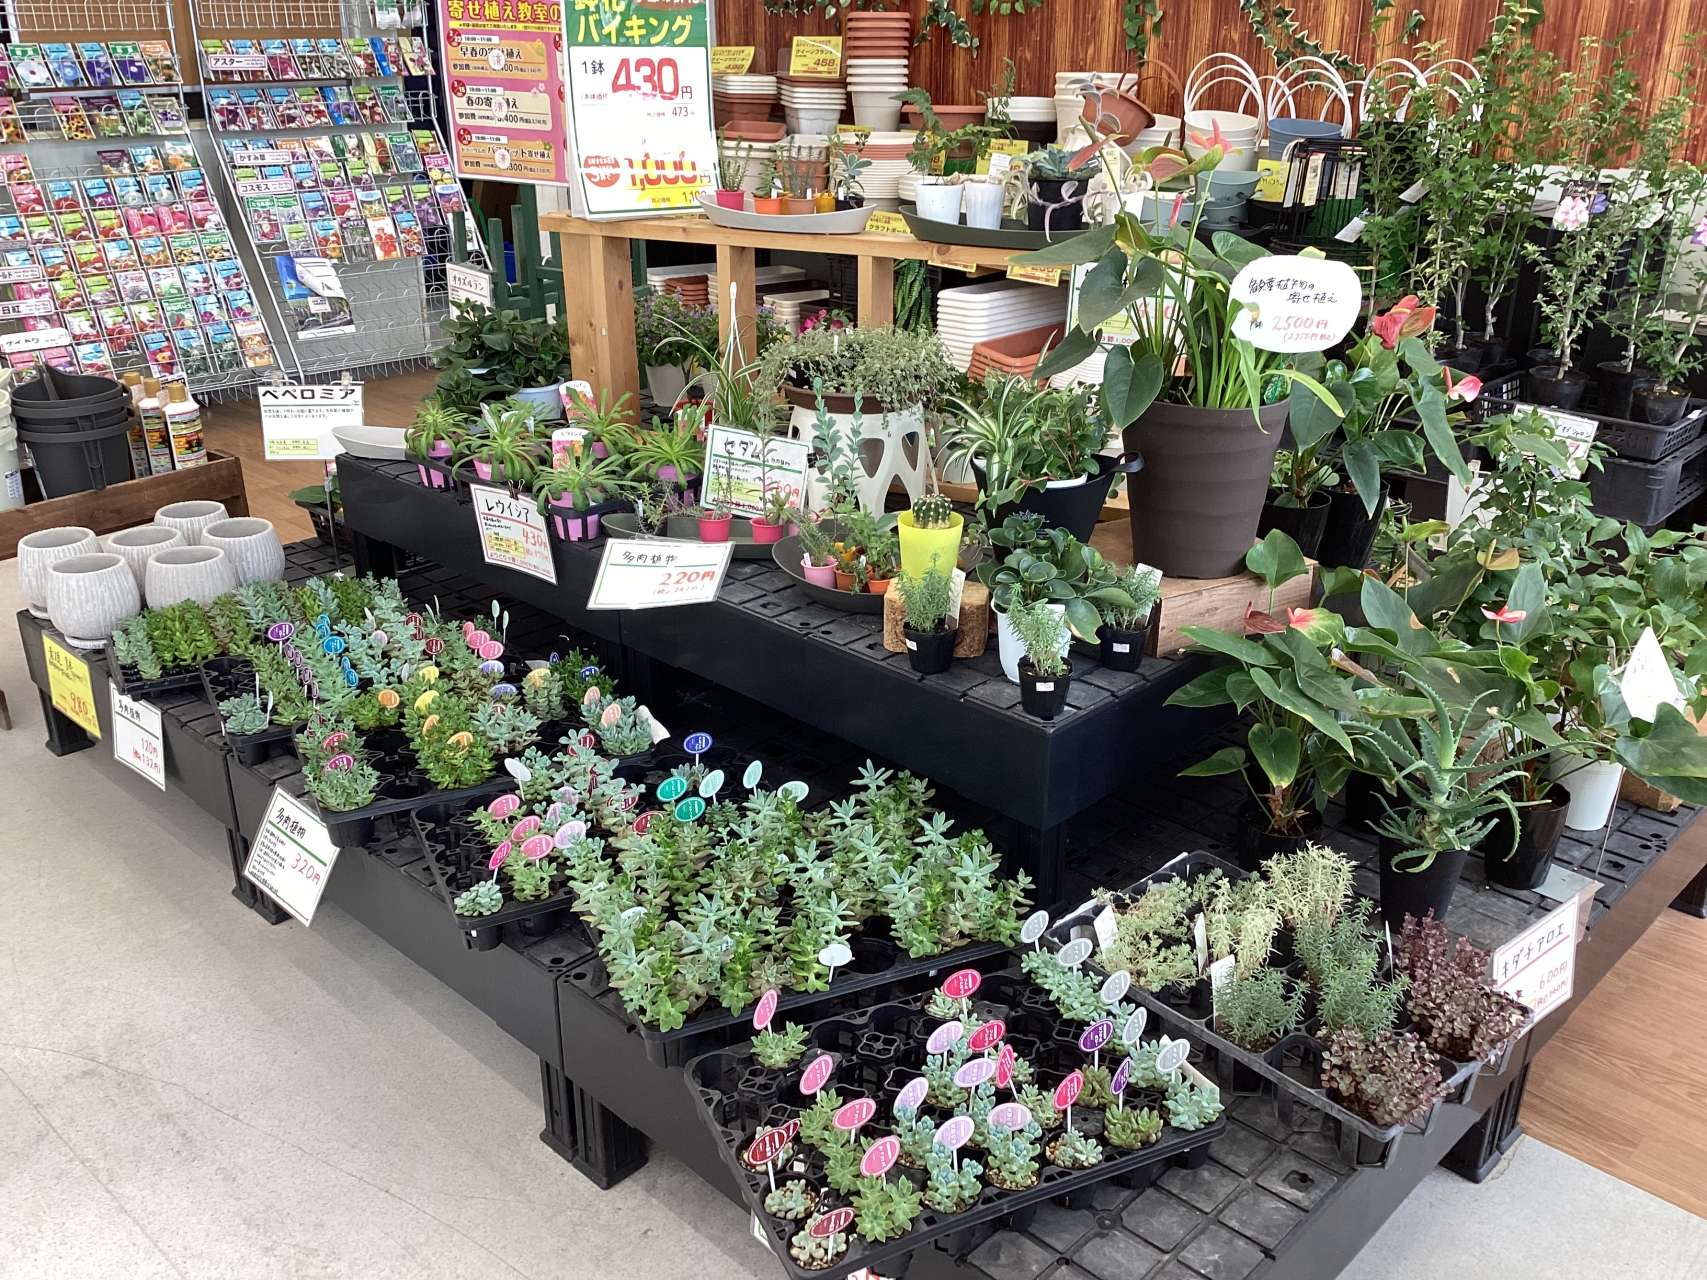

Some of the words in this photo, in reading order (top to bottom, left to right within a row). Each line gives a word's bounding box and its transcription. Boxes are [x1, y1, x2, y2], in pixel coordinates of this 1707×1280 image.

[577, 14, 692, 44] バイキング
[213, 58, 242, 66] アスター
[612, 58, 692, 100] 430円
[240, 184, 271, 192] コスモス
[724, 436, 762, 460] セダム
[485, 498, 529, 522] レウイシア
[659, 571, 715, 586] 220円
[276, 807, 306, 840] 多肉植物
[290, 852, 321, 886] 320円
[1502, 922, 1565, 979] キダチアロエ
